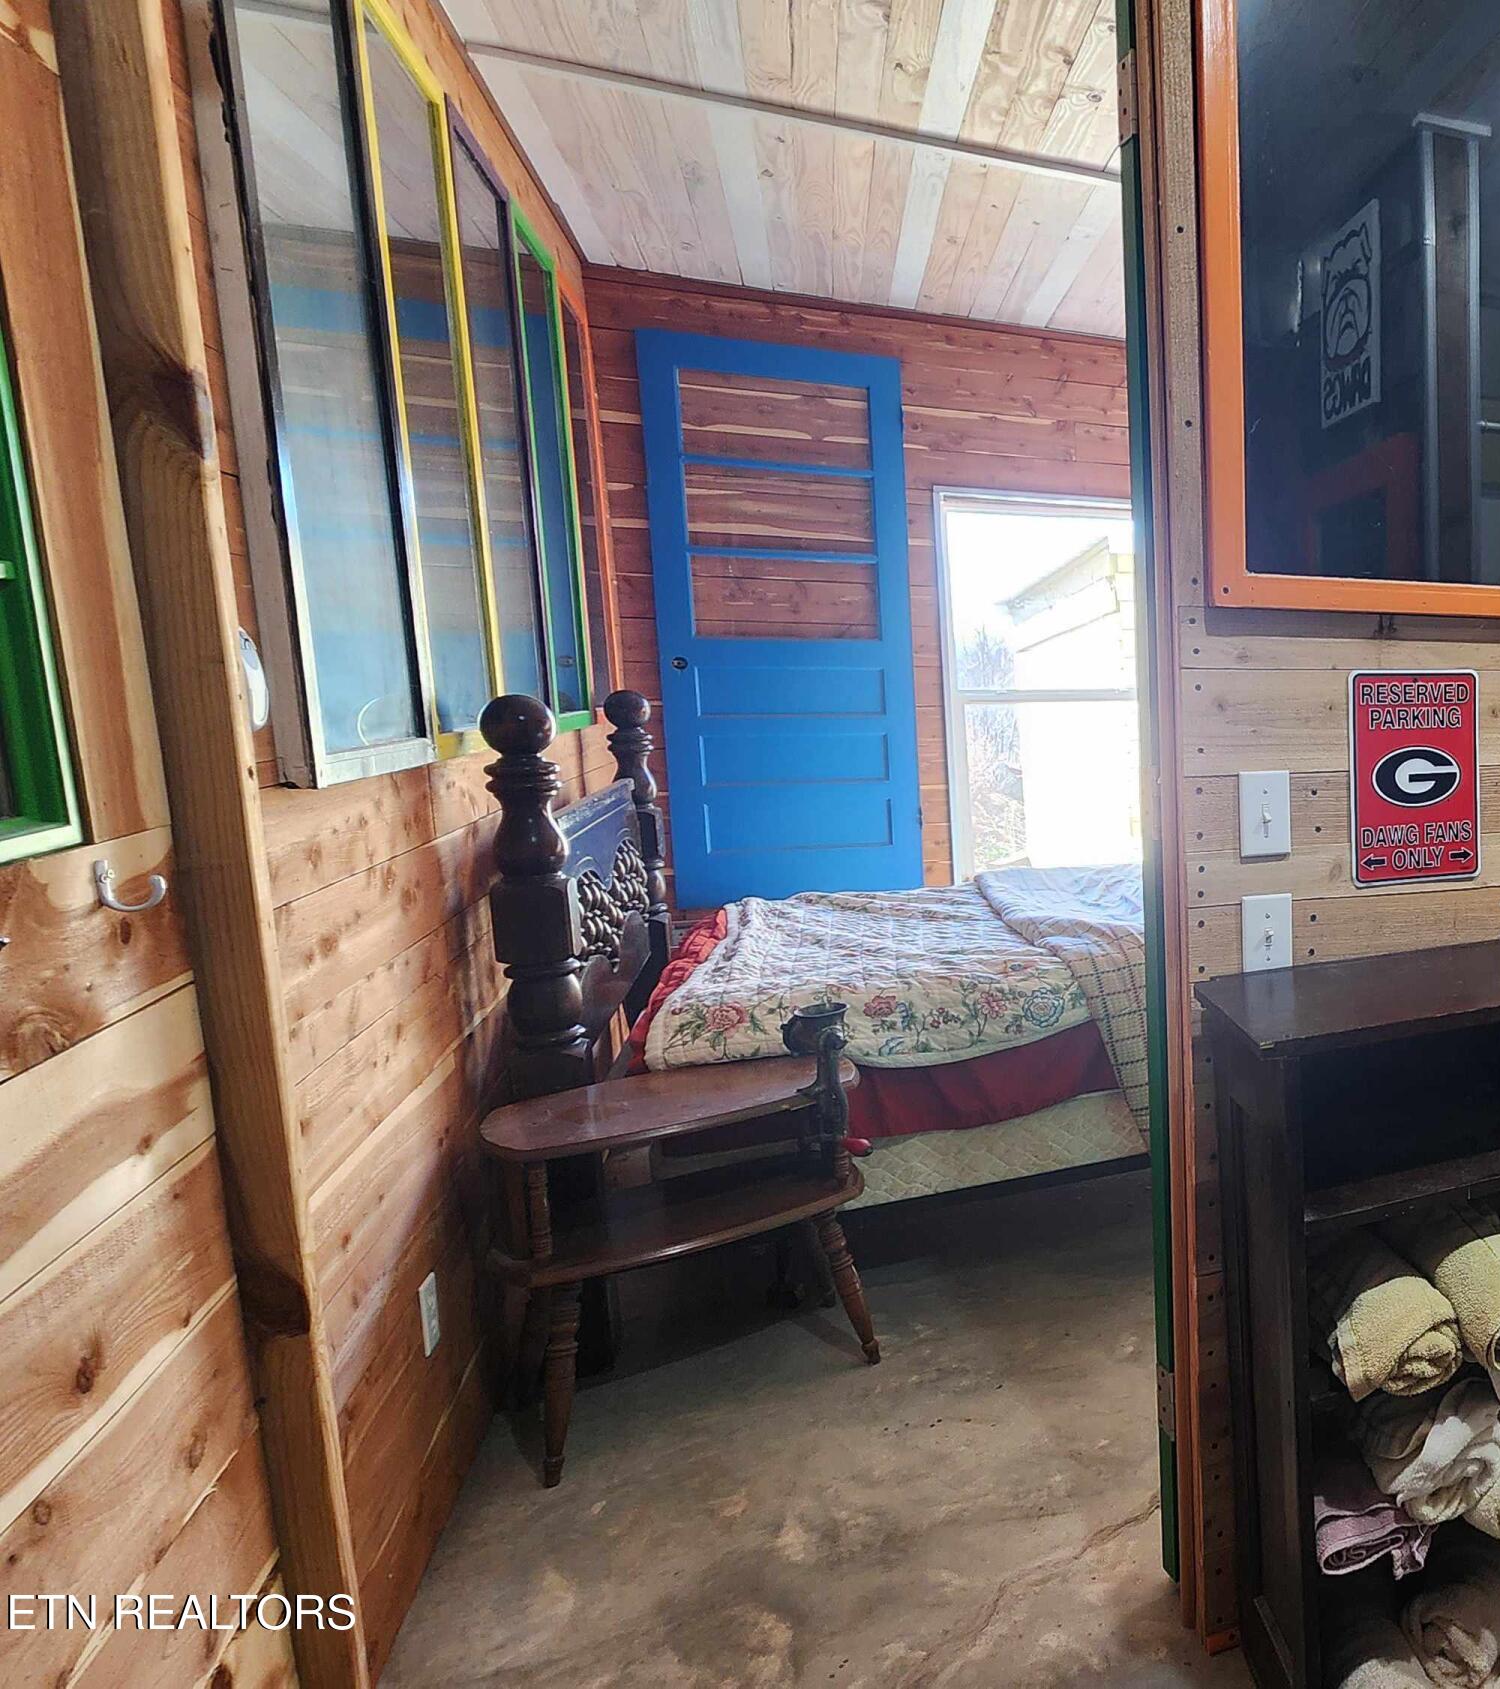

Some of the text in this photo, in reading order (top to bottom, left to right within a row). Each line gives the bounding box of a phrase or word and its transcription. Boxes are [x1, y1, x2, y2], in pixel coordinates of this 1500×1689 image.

[1360, 682, 1470, 705] RESERVED
[1369, 707, 1461, 729] PARKING
[1373, 747, 1459, 806] G
[1361, 821, 1472, 848] DAWG FANS
[1392, 846, 1444, 870] ONLY
